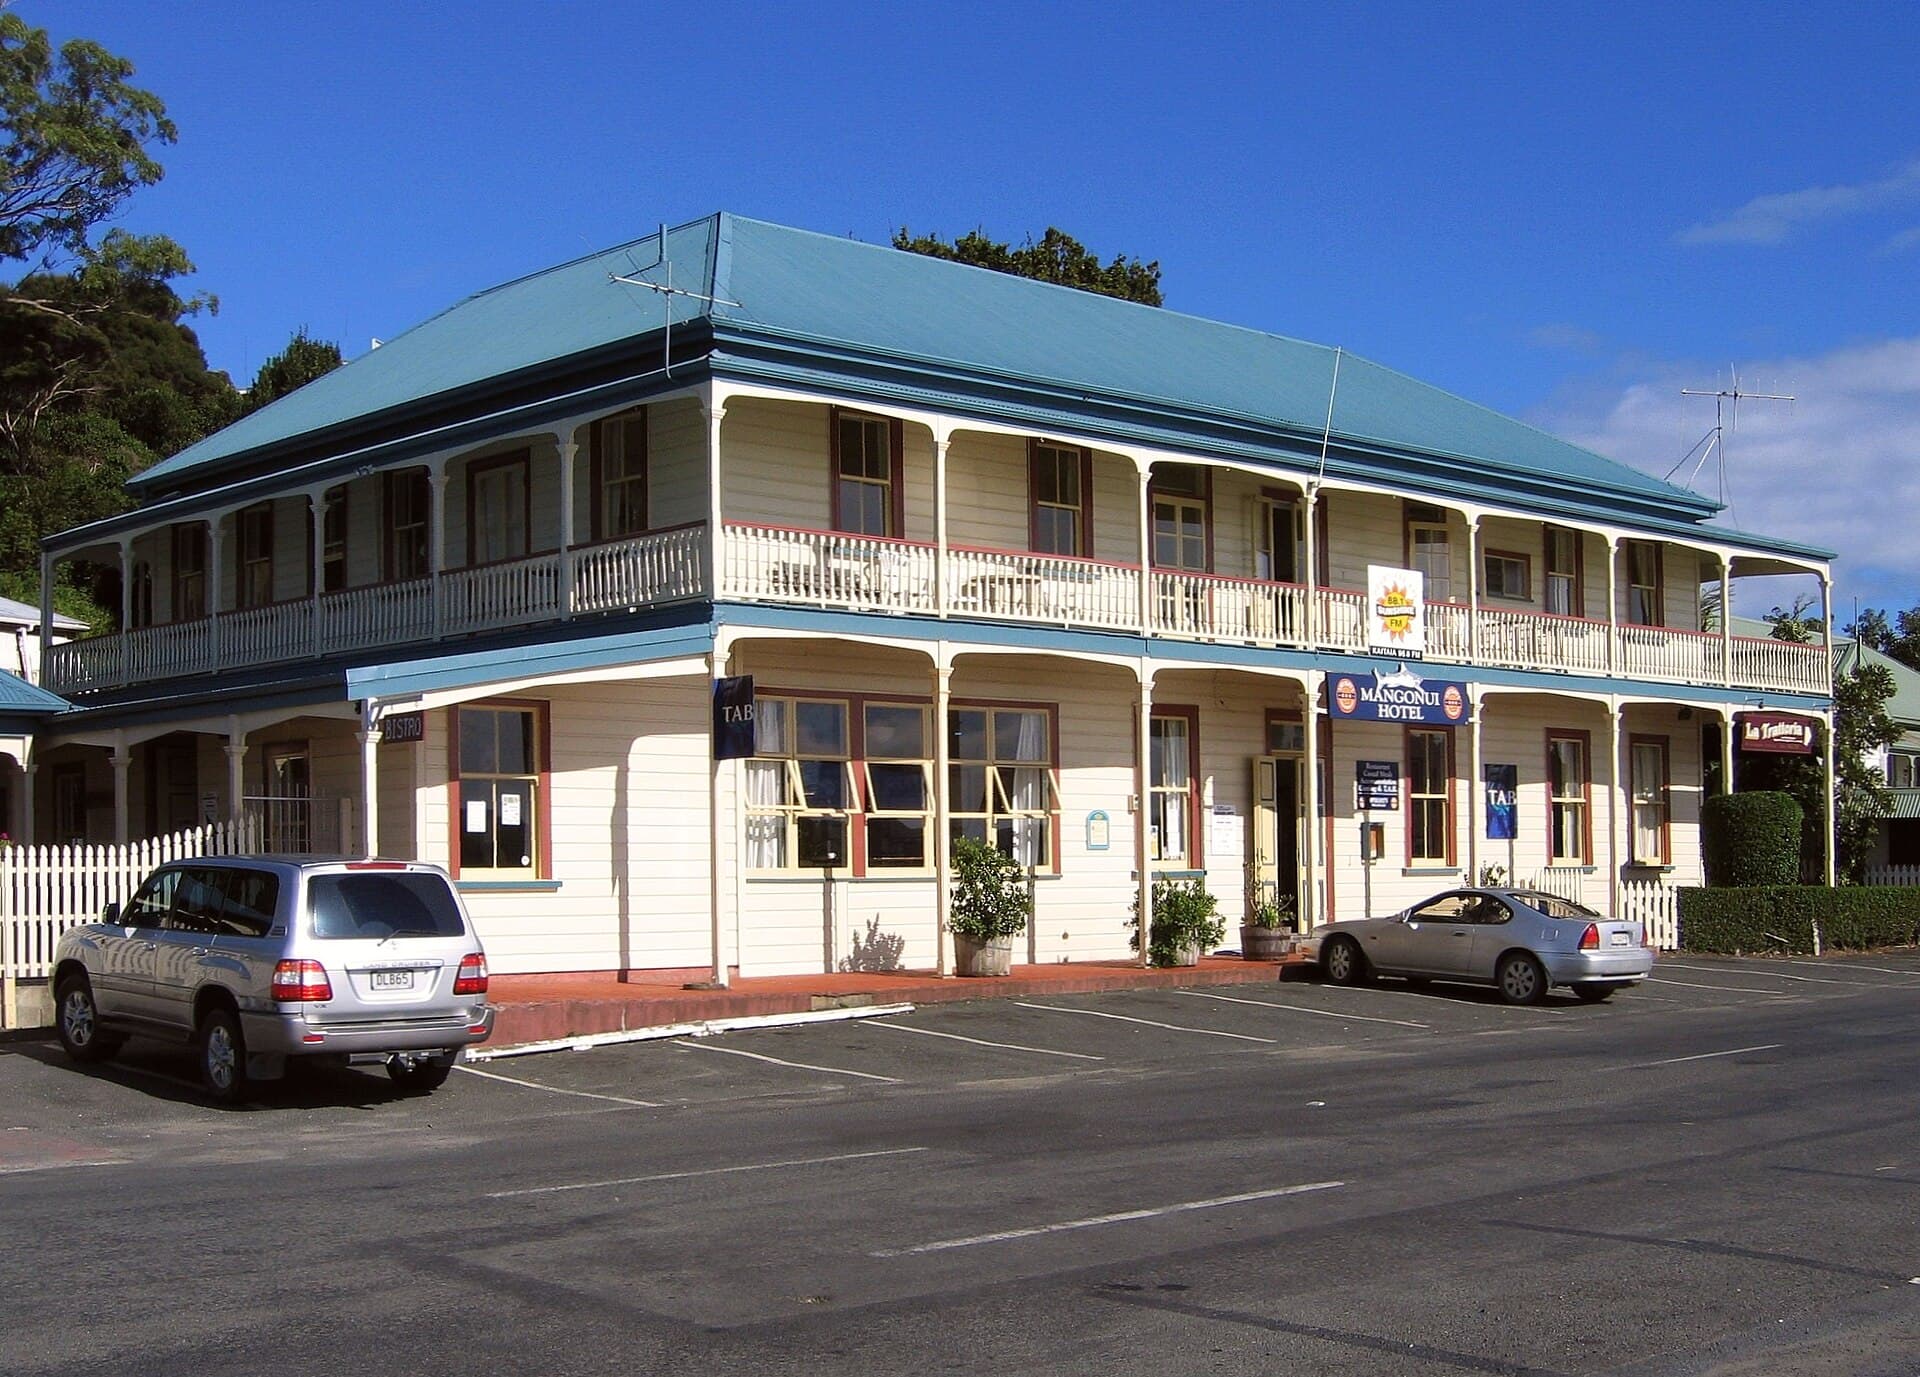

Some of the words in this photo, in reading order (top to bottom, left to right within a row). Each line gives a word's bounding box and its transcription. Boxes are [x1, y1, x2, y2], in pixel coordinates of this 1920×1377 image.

[1390, 619, 1402, 627] FM
[1360, 687, 1440, 706] MANGONUI
[722, 704, 753, 722] TAB
[1378, 704, 1425, 720] HOTEL
[385, 717, 421, 740] BISTRO
[1744, 722, 1760, 740] La
[1760, 721, 1803, 740] Trattoria
[1487, 789, 1517, 805] TAB
